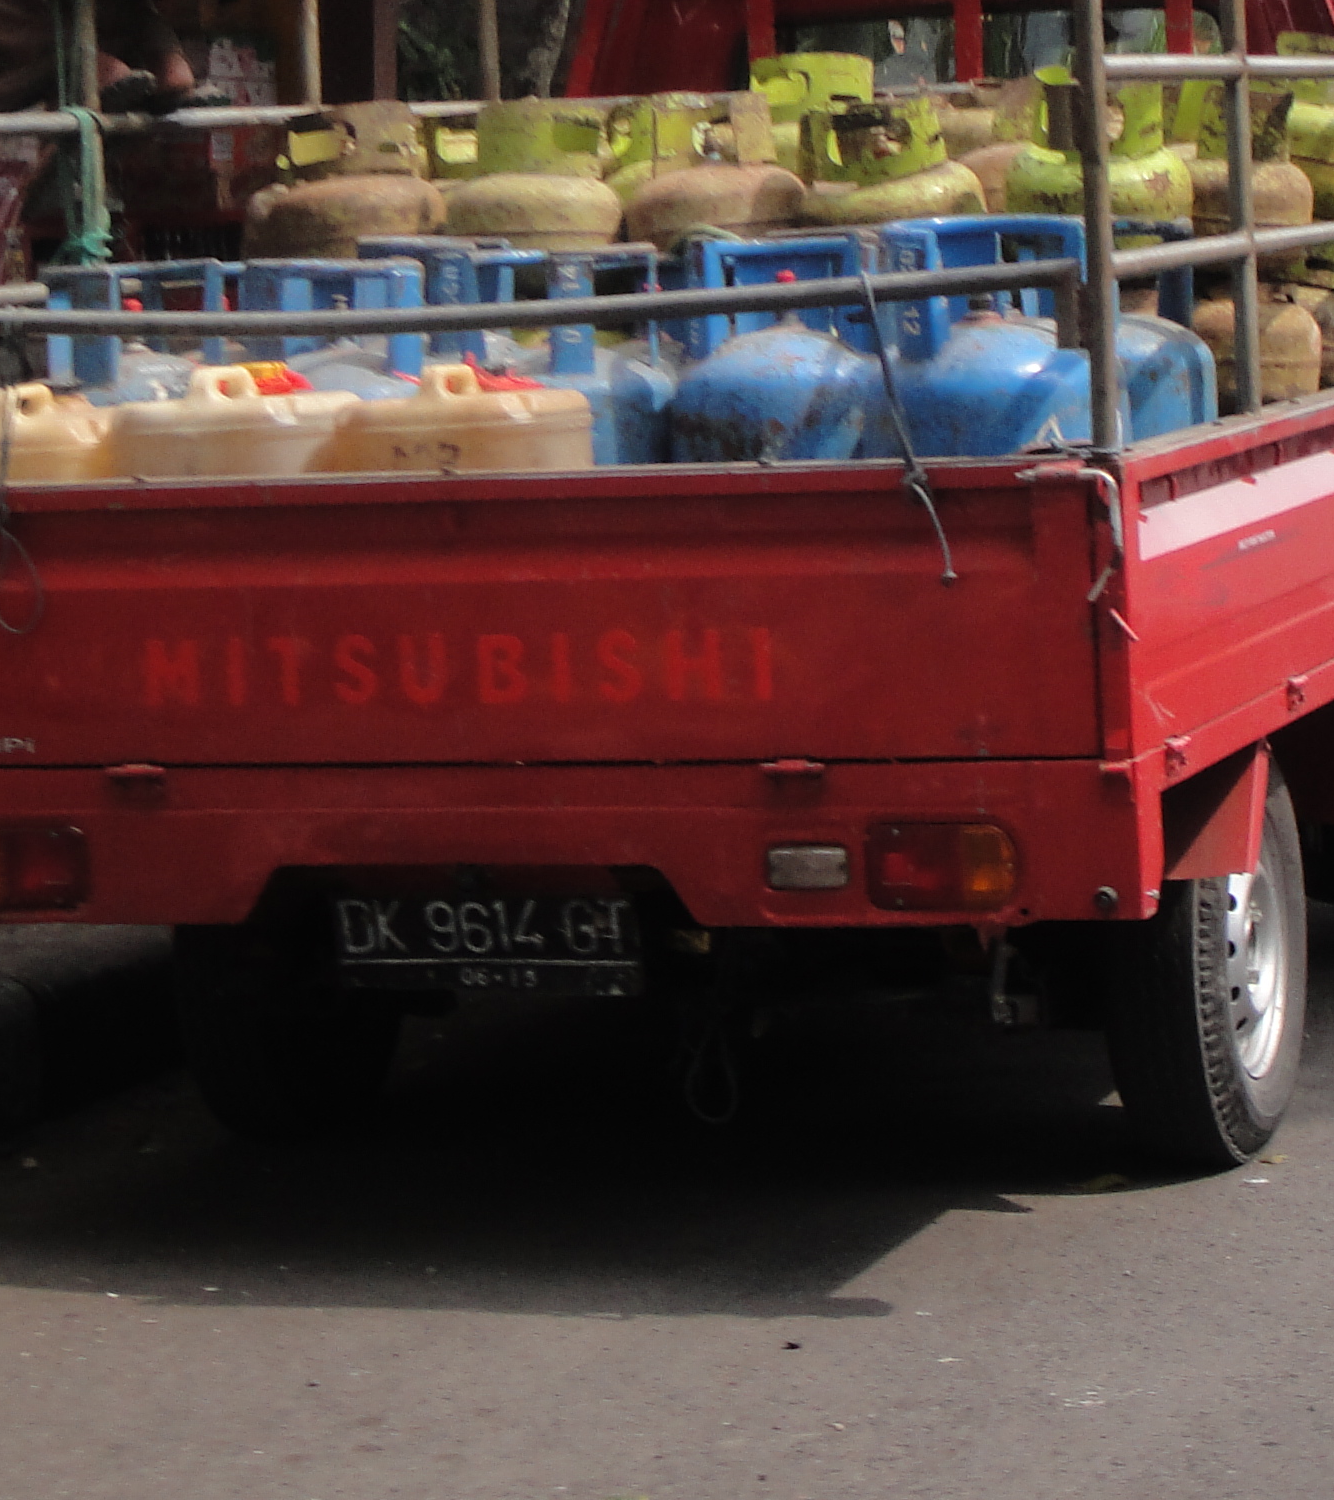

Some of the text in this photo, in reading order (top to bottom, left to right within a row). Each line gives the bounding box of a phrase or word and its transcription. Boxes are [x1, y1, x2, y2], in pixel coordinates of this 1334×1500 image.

[141, 626, 775, 706] MITSUBISHI
[336, 900, 408, 953] DK
[424, 900, 545, 953] 9614
